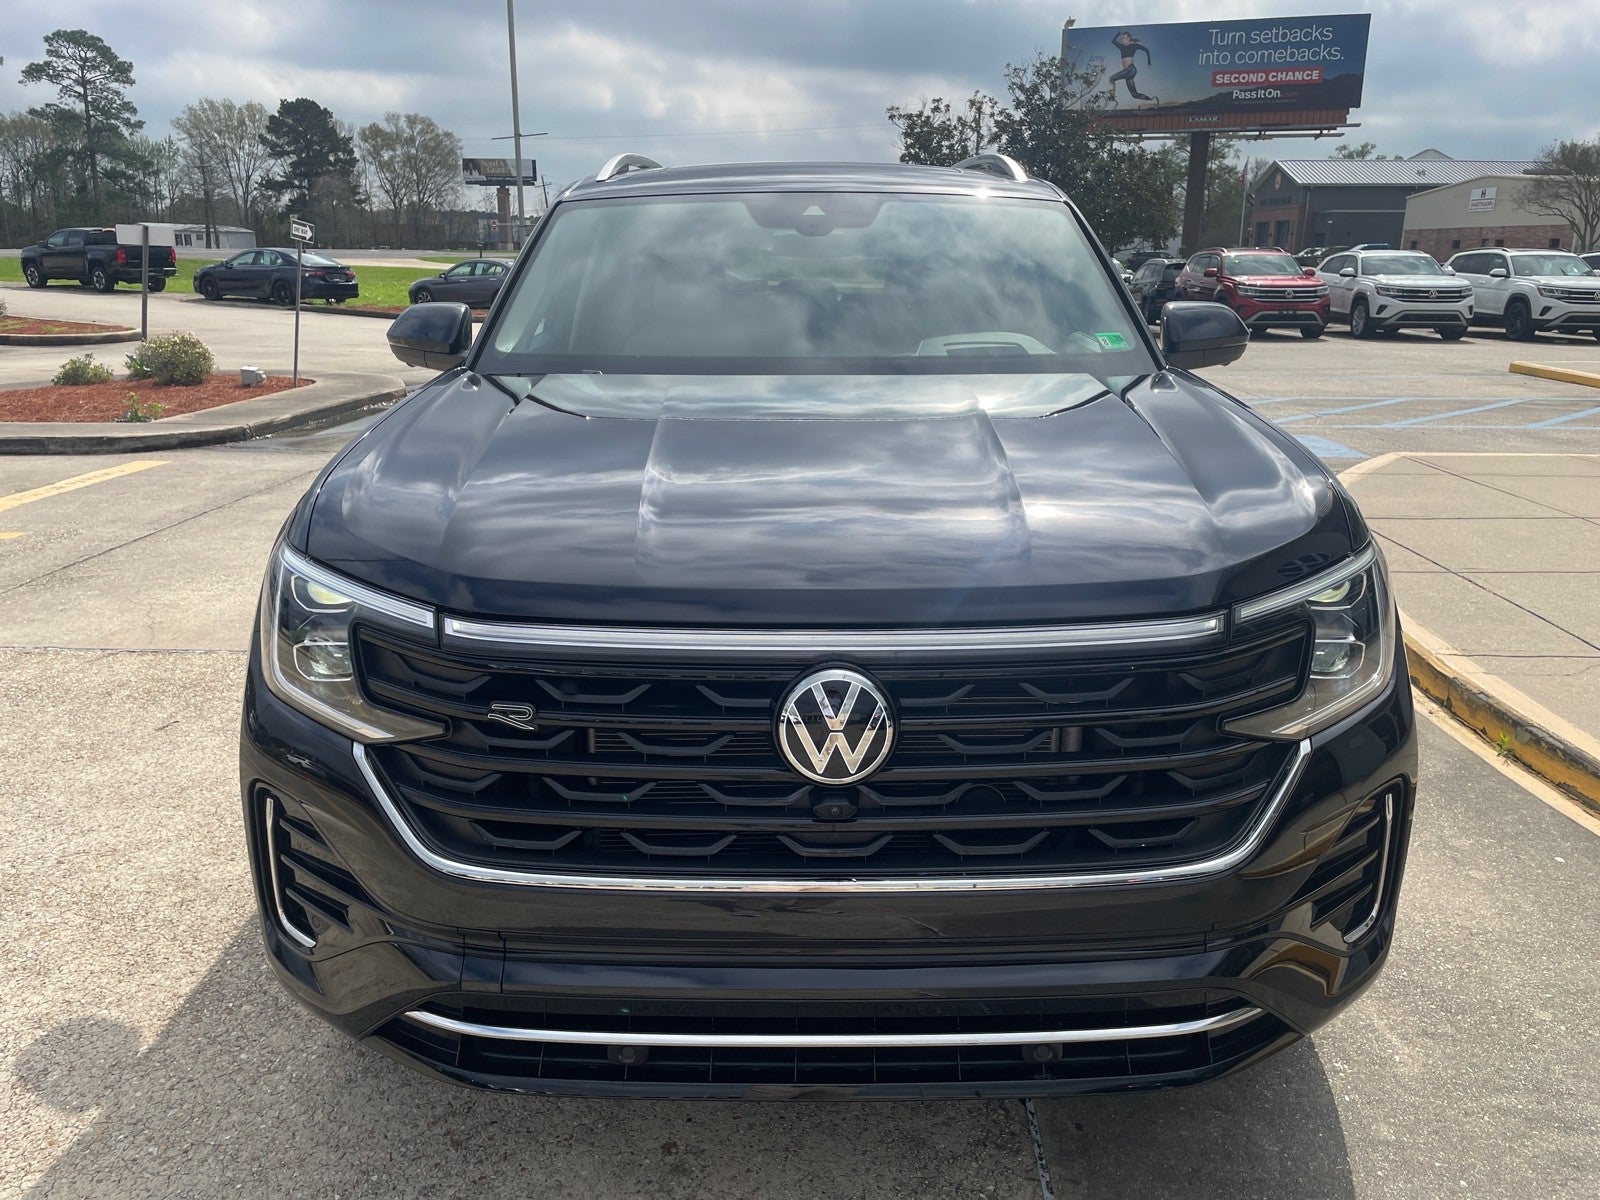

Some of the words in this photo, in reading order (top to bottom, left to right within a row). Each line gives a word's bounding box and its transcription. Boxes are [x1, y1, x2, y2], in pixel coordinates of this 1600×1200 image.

[1209, 28, 1246, 45] Turn
[1250, 24, 1333, 44] setbacks
[1198, 49, 1231, 66] into
[1235, 43, 1345, 64] comebacks.
[1215, 72, 1266, 84] SECOND
[1268, 70, 1320, 82] CHANCE
